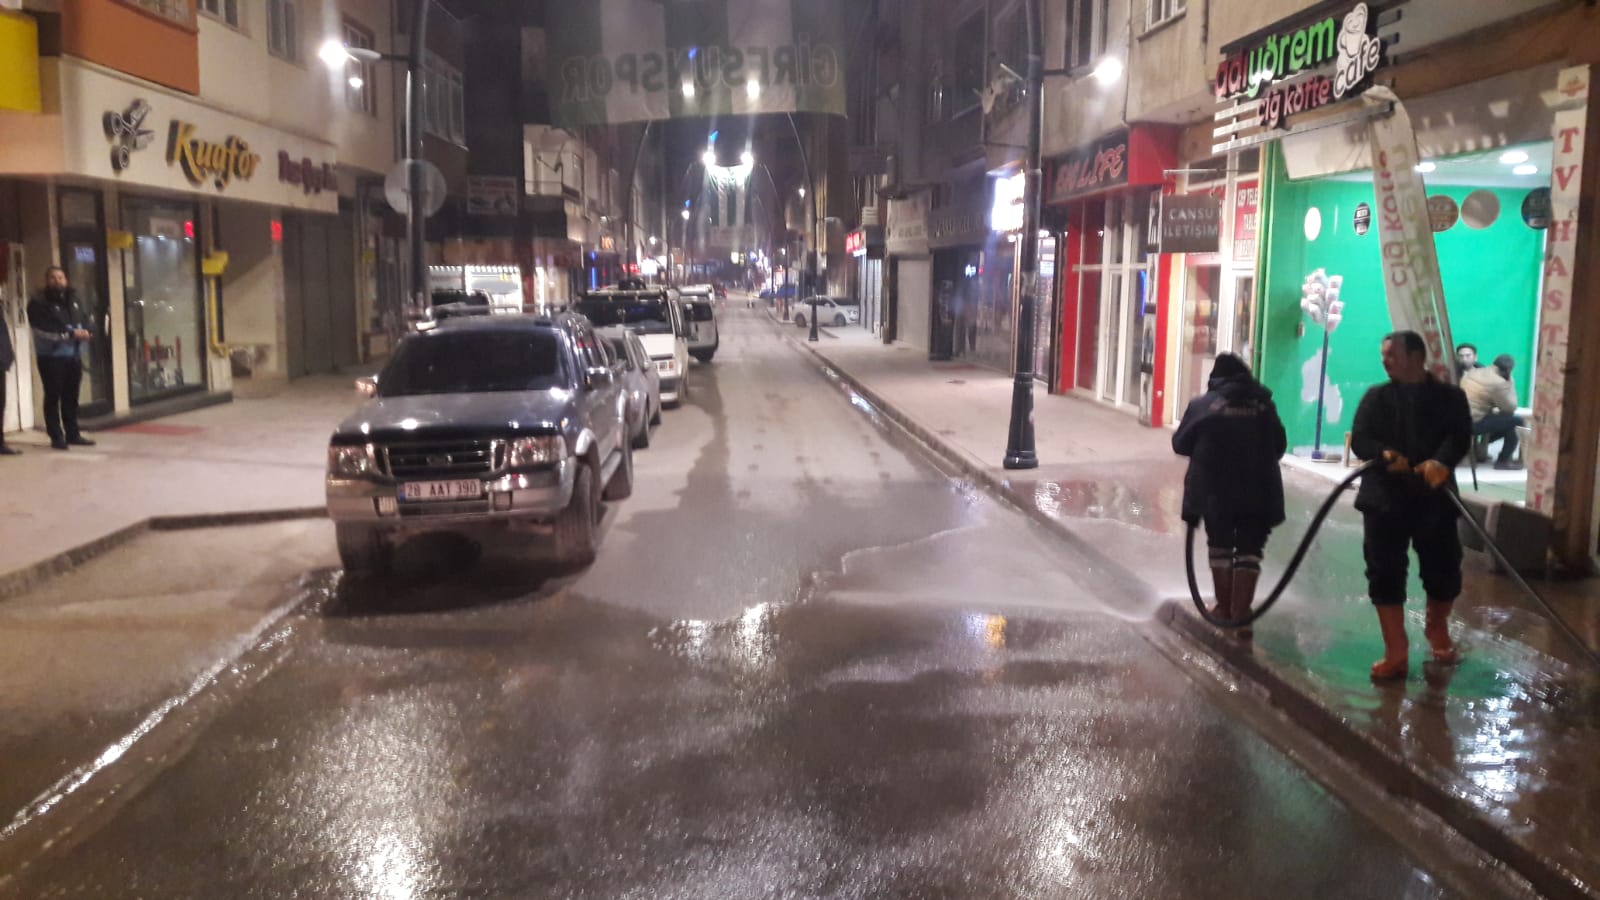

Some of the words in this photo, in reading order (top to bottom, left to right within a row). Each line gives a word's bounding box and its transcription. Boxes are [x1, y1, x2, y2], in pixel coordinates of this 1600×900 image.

[1334, 37, 1381, 99] cafe
[1554, 127, 1580, 193] TV
[1168, 207, 1214, 221] CANSU
